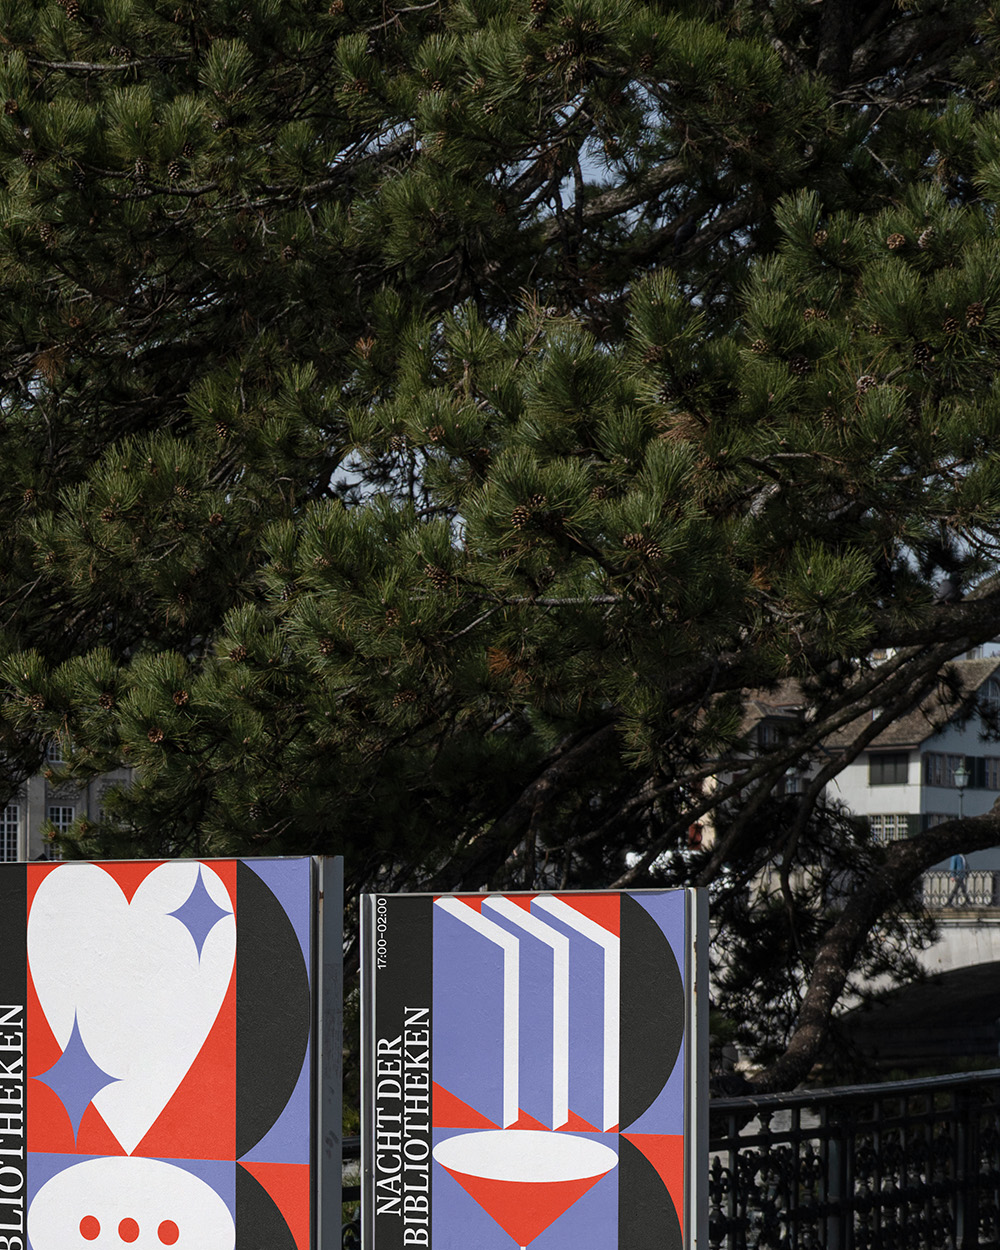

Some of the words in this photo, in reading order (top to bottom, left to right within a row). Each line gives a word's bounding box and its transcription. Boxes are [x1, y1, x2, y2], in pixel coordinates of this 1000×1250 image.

[376, 1034, 402, 1101] DER
[376, 1107, 402, 1217] NACHT
[403, 1006, 430, 1248] BIBLIOTHEKEN
